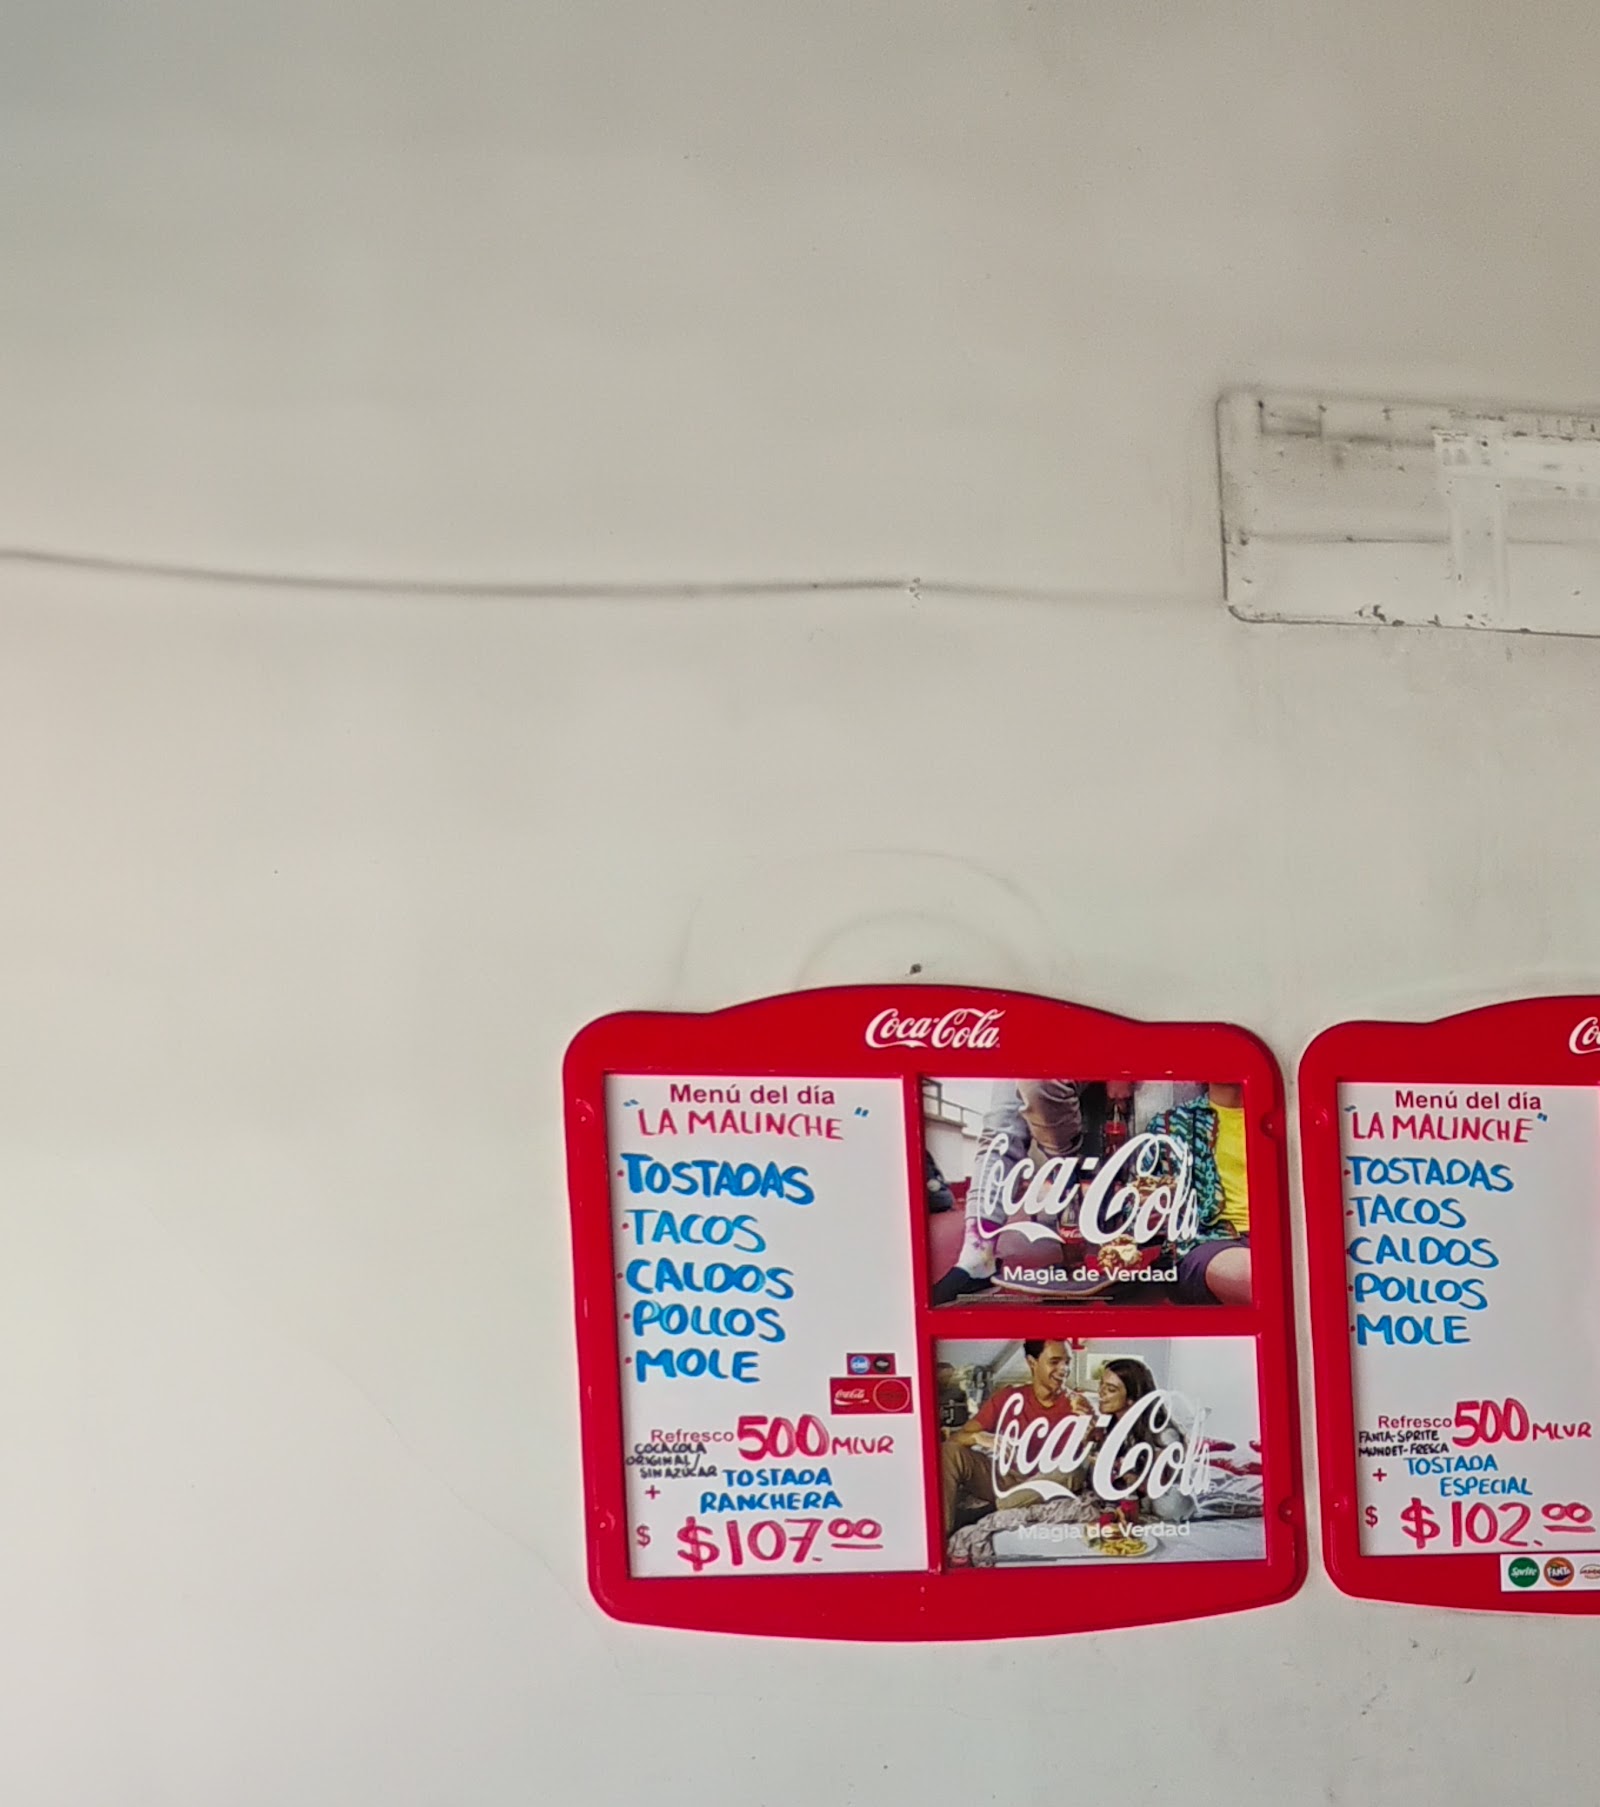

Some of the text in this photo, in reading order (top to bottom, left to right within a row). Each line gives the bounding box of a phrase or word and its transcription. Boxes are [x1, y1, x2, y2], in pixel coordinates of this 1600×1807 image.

[865, 1008, 1005, 1050] Coca-Cola
[670, 1083, 835, 1105] Menú del día
[1395, 1090, 1541, 1110] Menú del día
[620, 1153, 816, 1206] TOSTADAS
[977, 1133, 1200, 1244] Coca-Cola
[1346, 1156, 1515, 1192] TOSTADAS
[1349, 1194, 1467, 1228] TACOS
[625, 1209, 767, 1254] TACOS
[1348, 1233, 1500, 1268] CALDOS
[625, 1258, 795, 1299] CALDOS
[1003, 1265, 1178, 1285] Magia de Verdad
[1354, 1275, 1488, 1310] POLLOS
[633, 1301, 786, 1342] POLLOS
[1356, 1311, 1471, 1346] MOLE
[635, 1349, 761, 1383] MOLE
[651, 1429, 734, 1443] Refresco
[736, 1413, 830, 1461] 500
[1377, 1415, 1452, 1429] Refresco
[1452, 1398, 1529, 1447] 500
[992, 1389, 1212, 1501] Coca-Cola
[722, 1466, 833, 1487] TOSTADA
[1403, 1454, 1499, 1475] TOSTADA
[700, 1490, 843, 1514] RANCHERA
[1439, 1477, 1534, 1497] ESPECIAL
[1017, 1521, 1191, 1543] Magia de Verdad
[1510, 1567, 1538, 1579] Sprite
